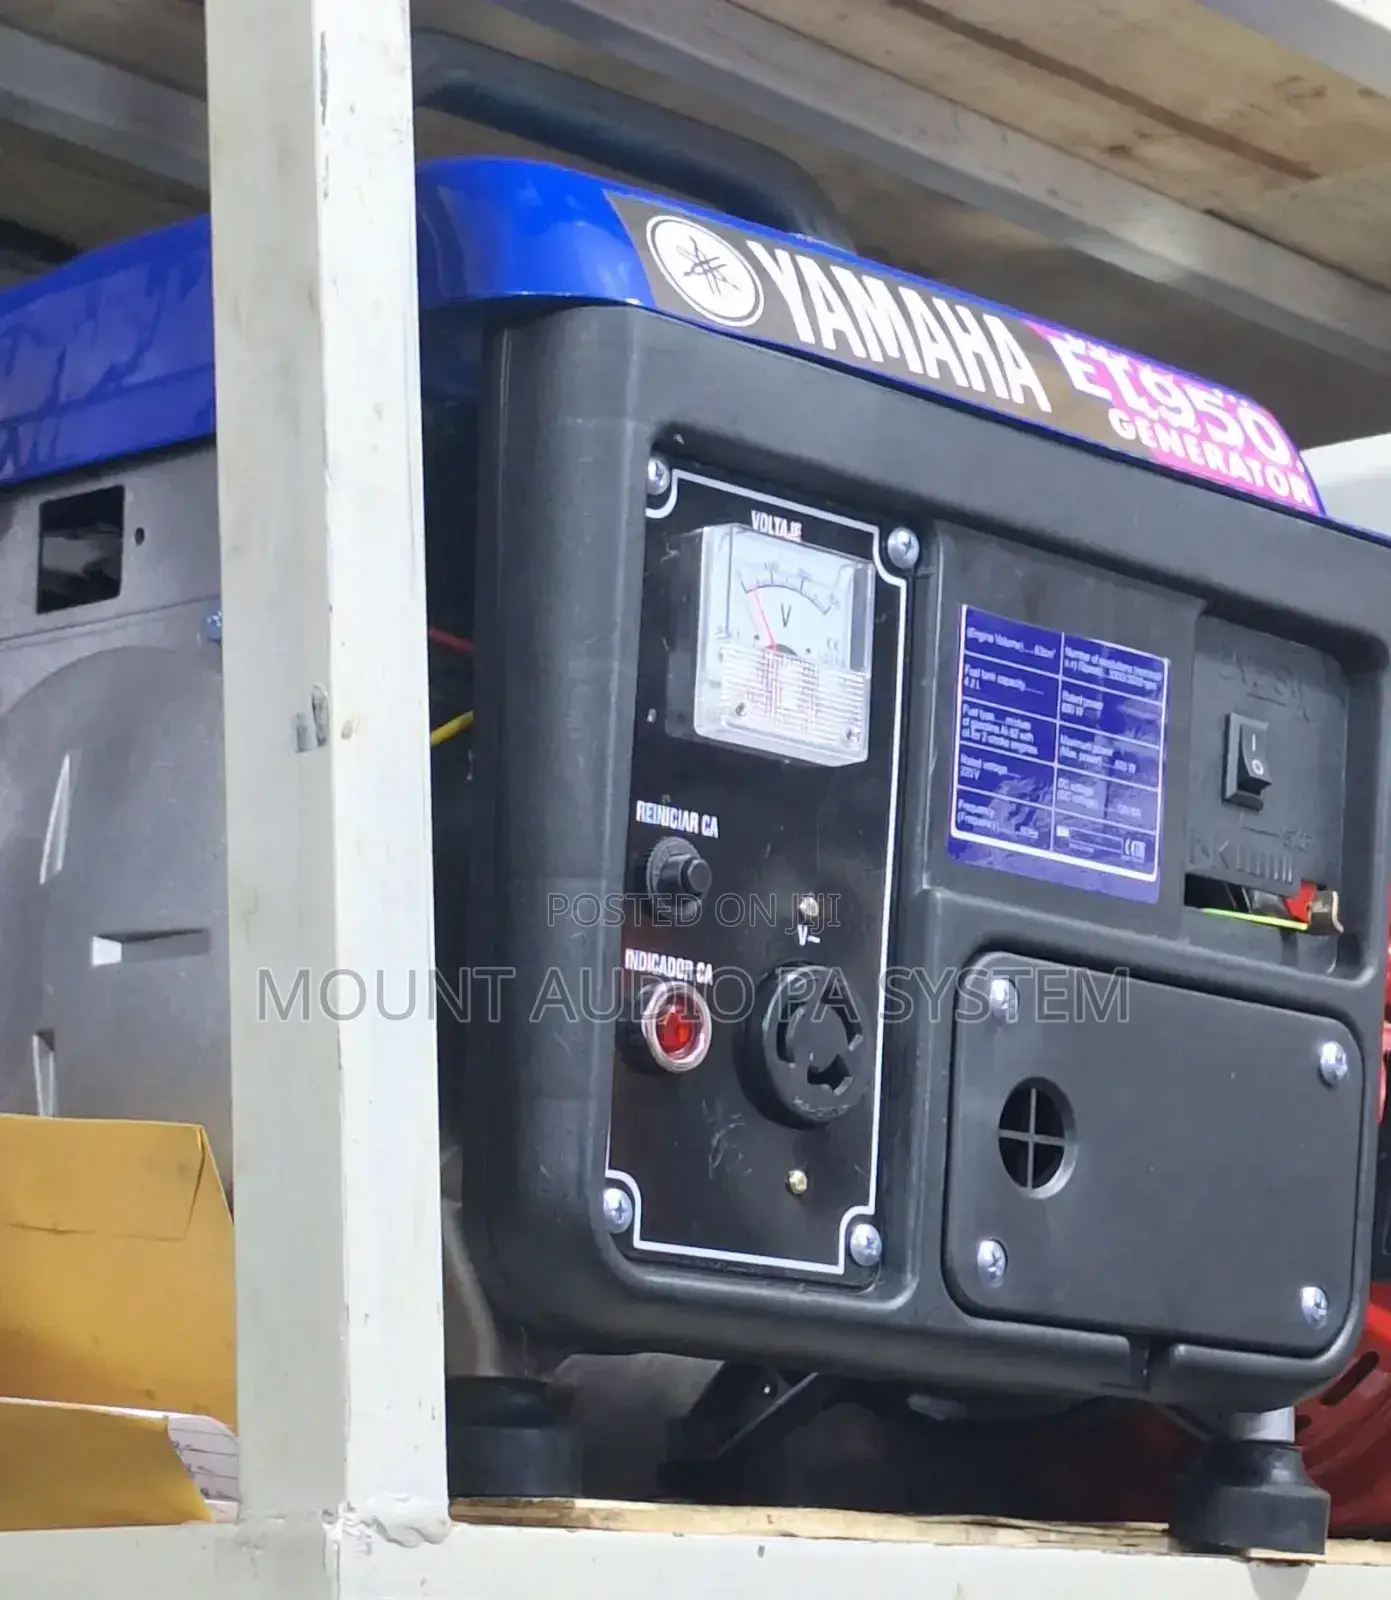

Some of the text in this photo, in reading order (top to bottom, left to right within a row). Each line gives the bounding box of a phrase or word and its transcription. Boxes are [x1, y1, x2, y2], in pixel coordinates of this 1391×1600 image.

[745, 238, 1052, 413] YAMAHA
[1107, 407, 1314, 507] GENERATOR
[780, 602, 792, 628] V
[636, 800, 719, 839] REINICIAR CA
[624, 948, 714, 986] INDICADOR CA
